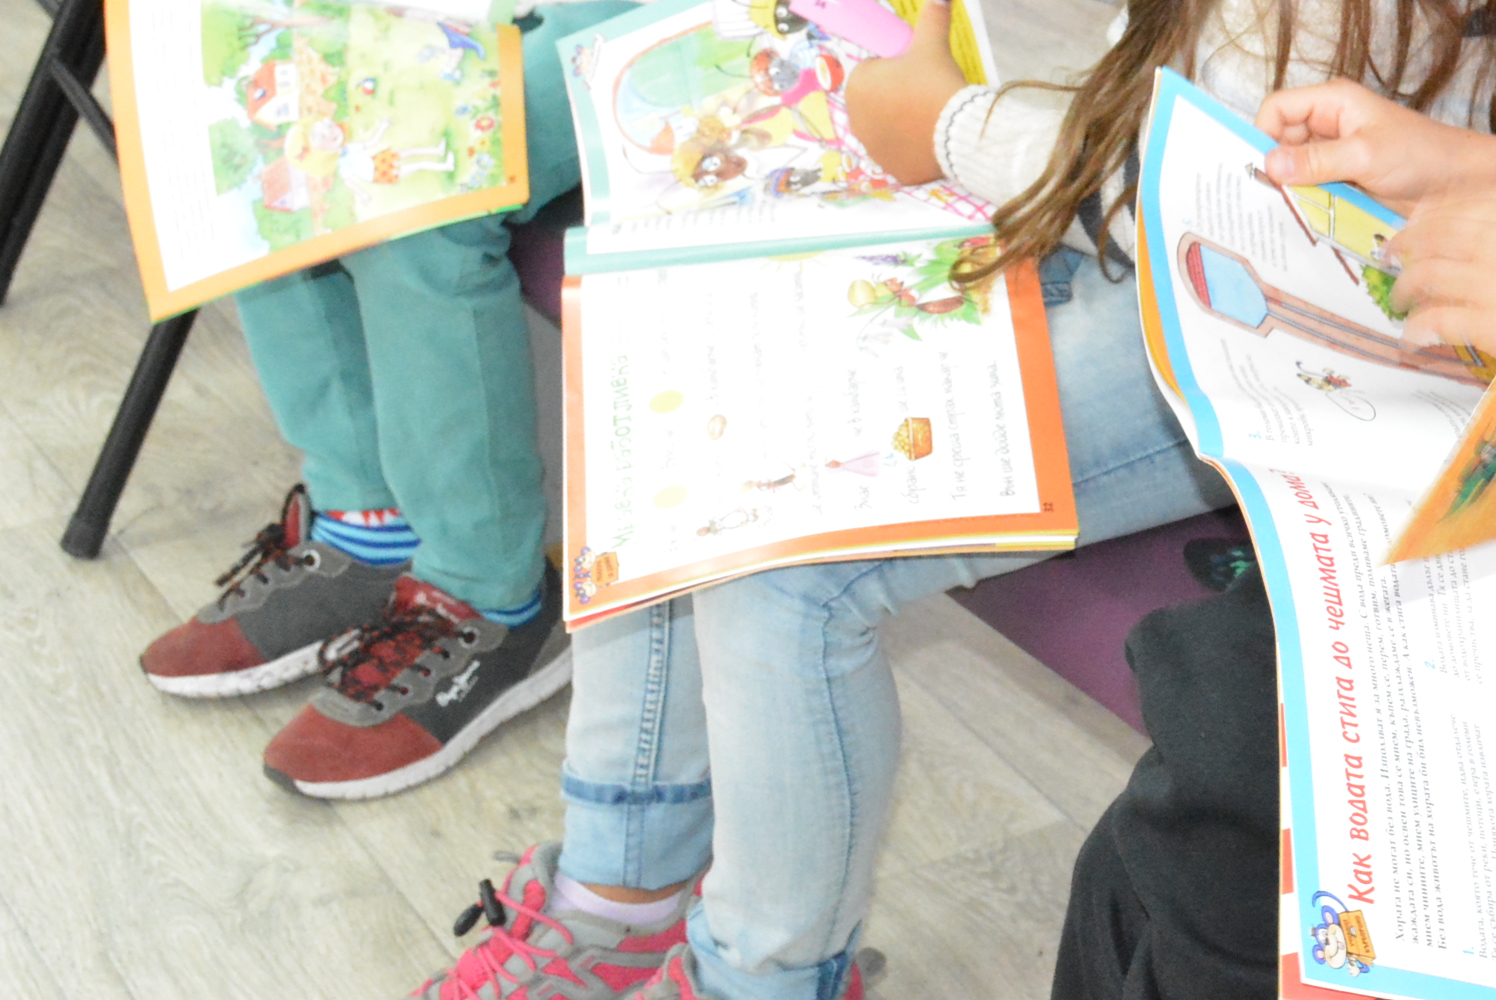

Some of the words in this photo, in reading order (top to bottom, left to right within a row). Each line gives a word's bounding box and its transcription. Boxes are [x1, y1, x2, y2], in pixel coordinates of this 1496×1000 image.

[1303, 513, 1332, 525] у
[1309, 532, 1345, 630] чешмата
[1330, 641, 1353, 669] до
[1335, 676, 1360, 743] стига
[1343, 753, 1369, 841] водата
[1346, 853, 1375, 904] Как
